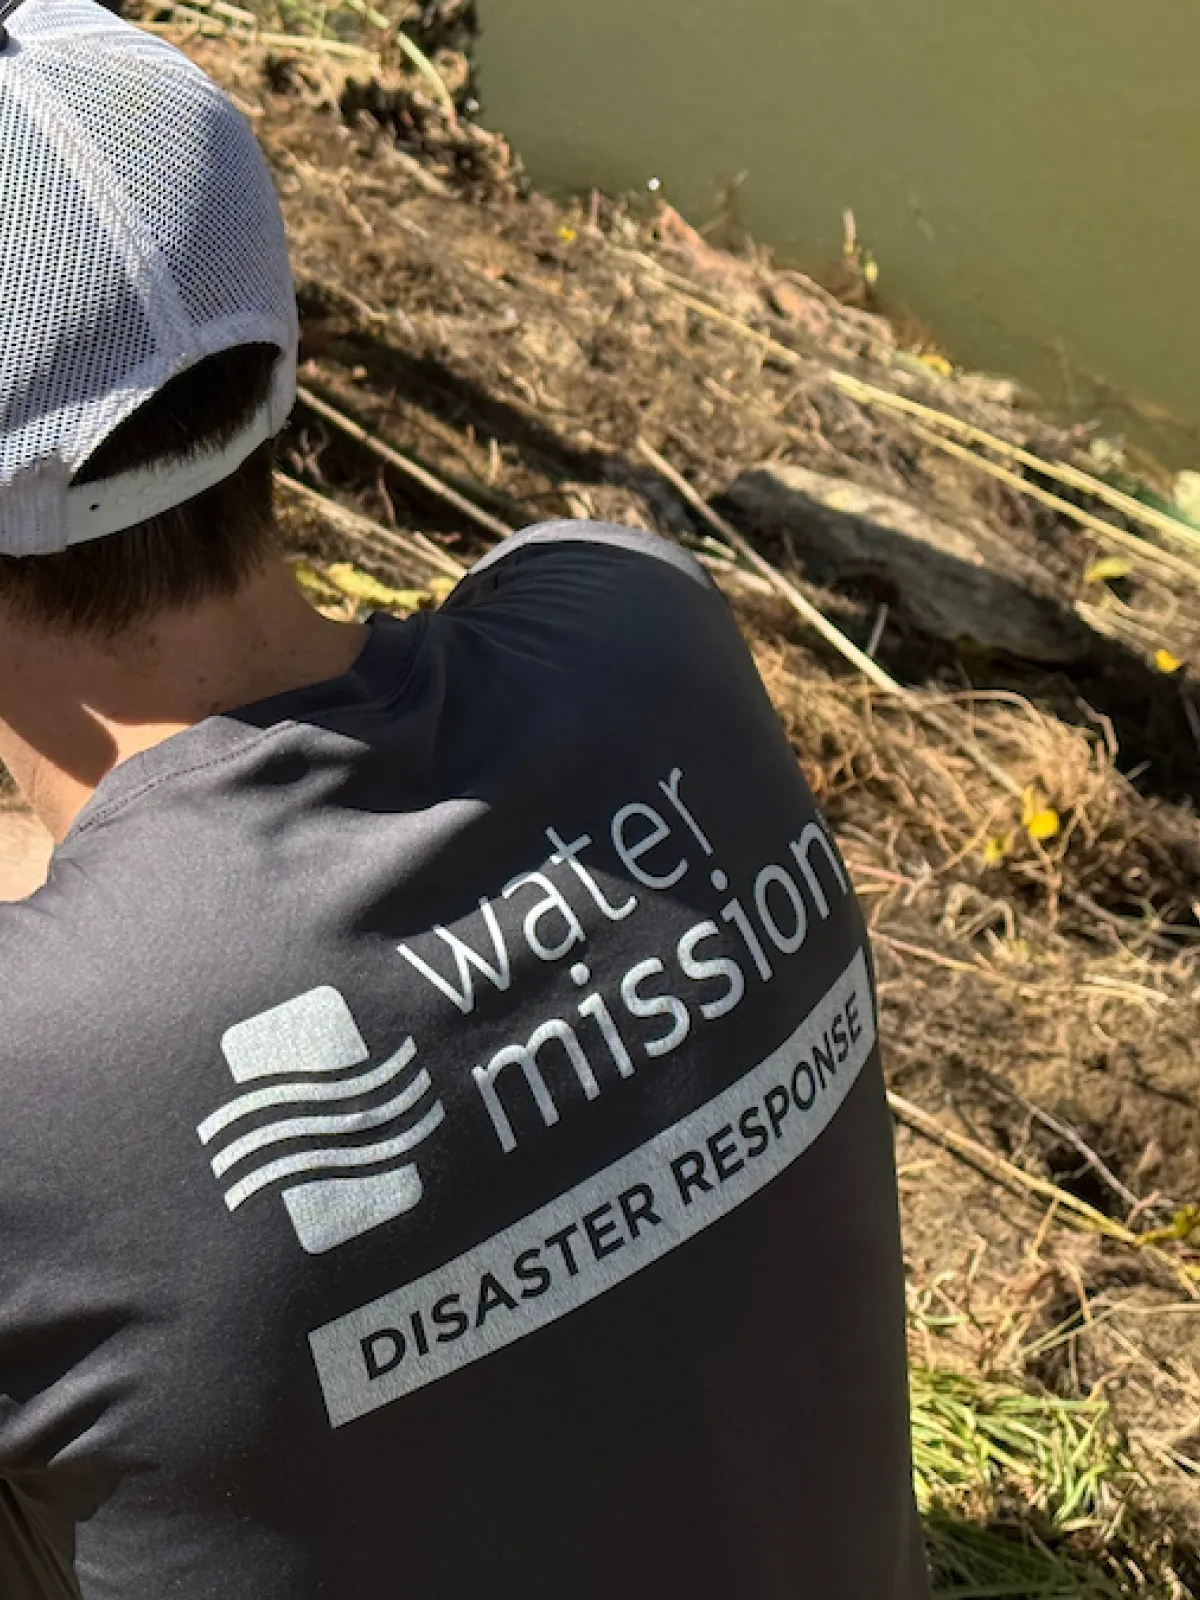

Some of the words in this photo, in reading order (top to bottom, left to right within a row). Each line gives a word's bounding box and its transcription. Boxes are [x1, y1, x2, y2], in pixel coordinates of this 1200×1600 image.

[396, 767, 713, 1014] water
[470, 822, 849, 1153] mission
[358, 1182, 662, 1381] DISASTER
[669, 992, 863, 1205] RESPONSE
